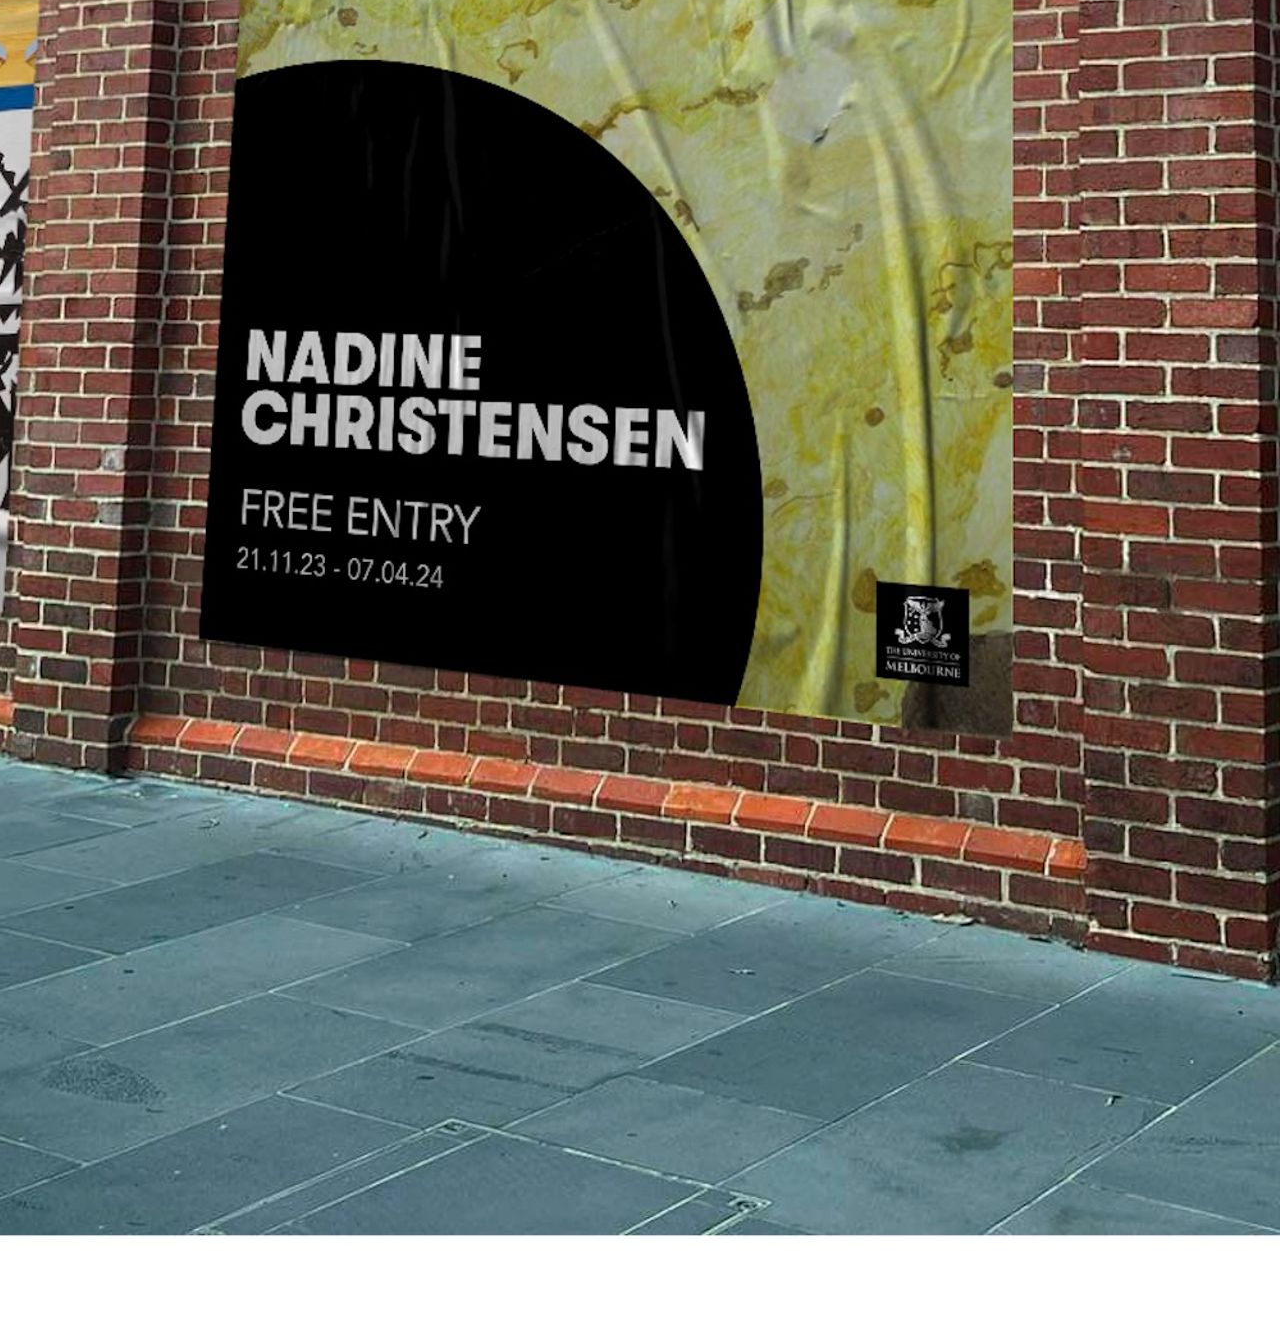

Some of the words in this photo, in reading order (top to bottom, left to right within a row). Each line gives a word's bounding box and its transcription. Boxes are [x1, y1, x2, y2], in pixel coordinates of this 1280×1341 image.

[246, 329, 481, 391] NADINE
[242, 390, 705, 471] CHRISTENSEN
[241, 489, 333, 532] FREE
[347, 497, 481, 545] ENTRY
[237, 546, 326, 578] 21.11.23
[347, 557, 444, 589] 07.04.24
[885, 645, 901, 656] THE
[902, 647, 948, 660] UNIVERSITY
[885, 660, 961, 678] MELBOURNE
